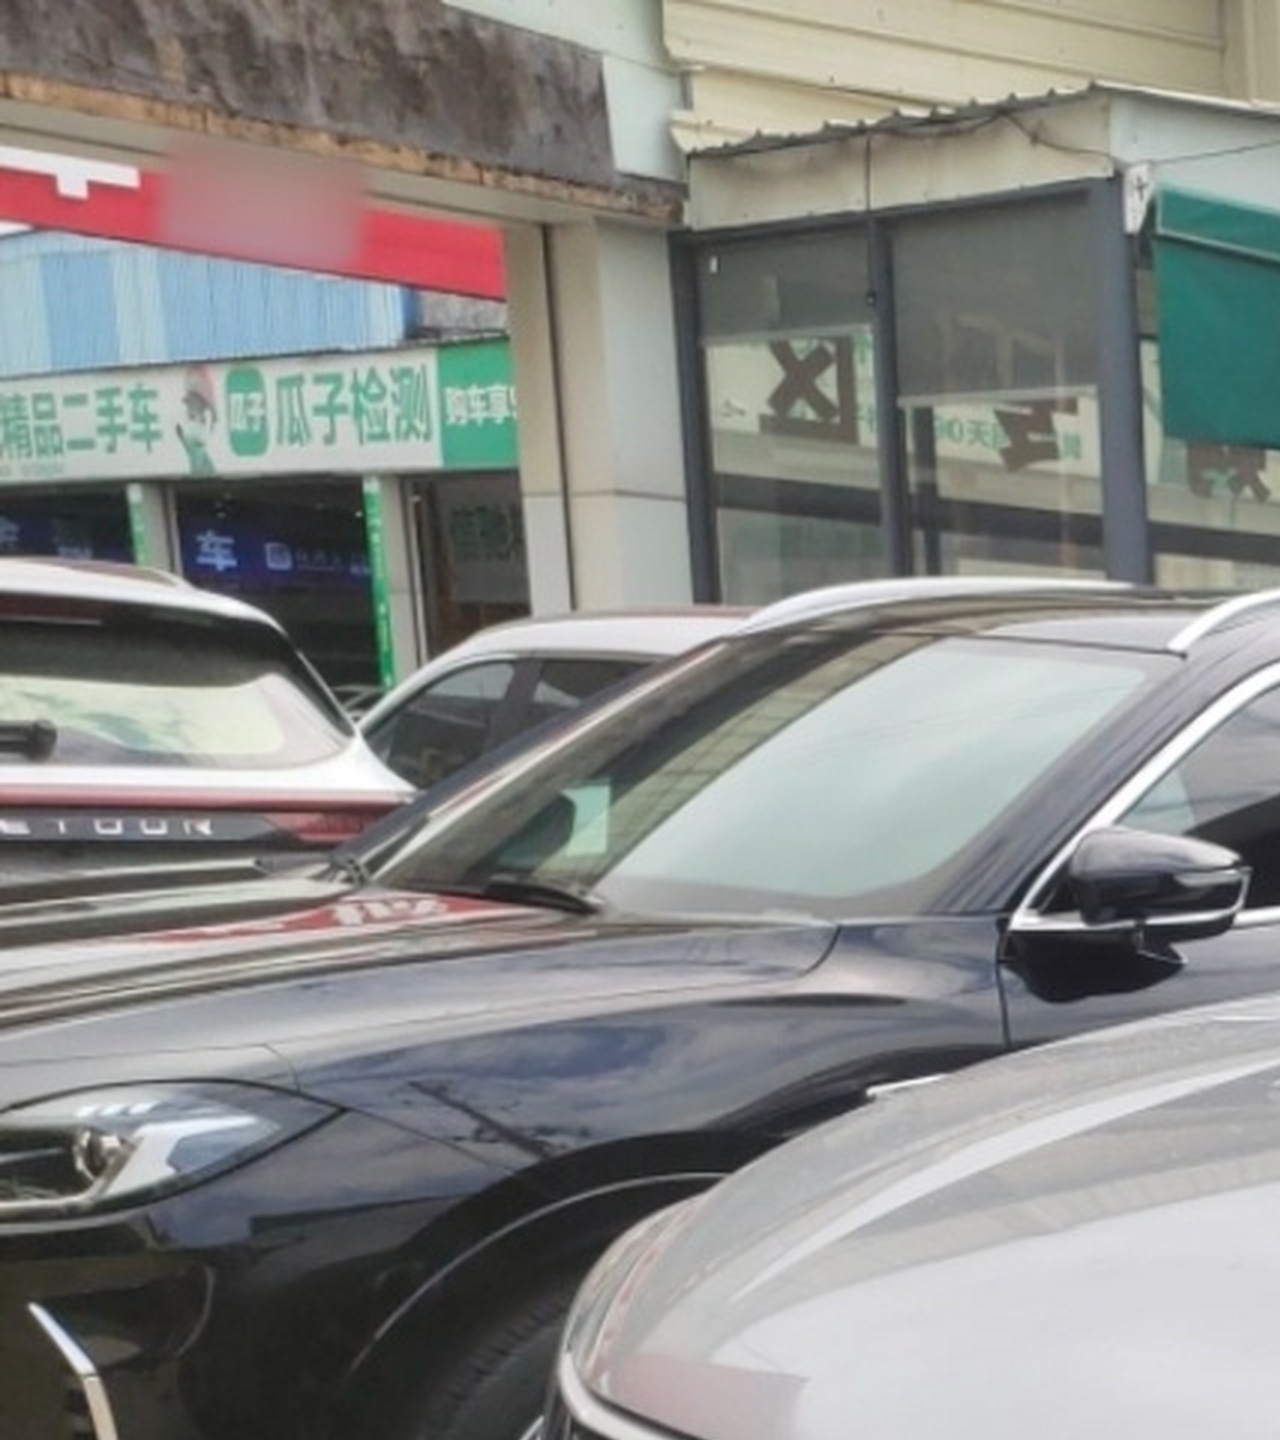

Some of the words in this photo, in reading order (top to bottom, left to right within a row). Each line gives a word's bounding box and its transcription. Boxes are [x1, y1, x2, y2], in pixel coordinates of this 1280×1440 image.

[0, 383, 163, 460] 精品二手车
[276, 363, 432, 446] 瓜子检测
